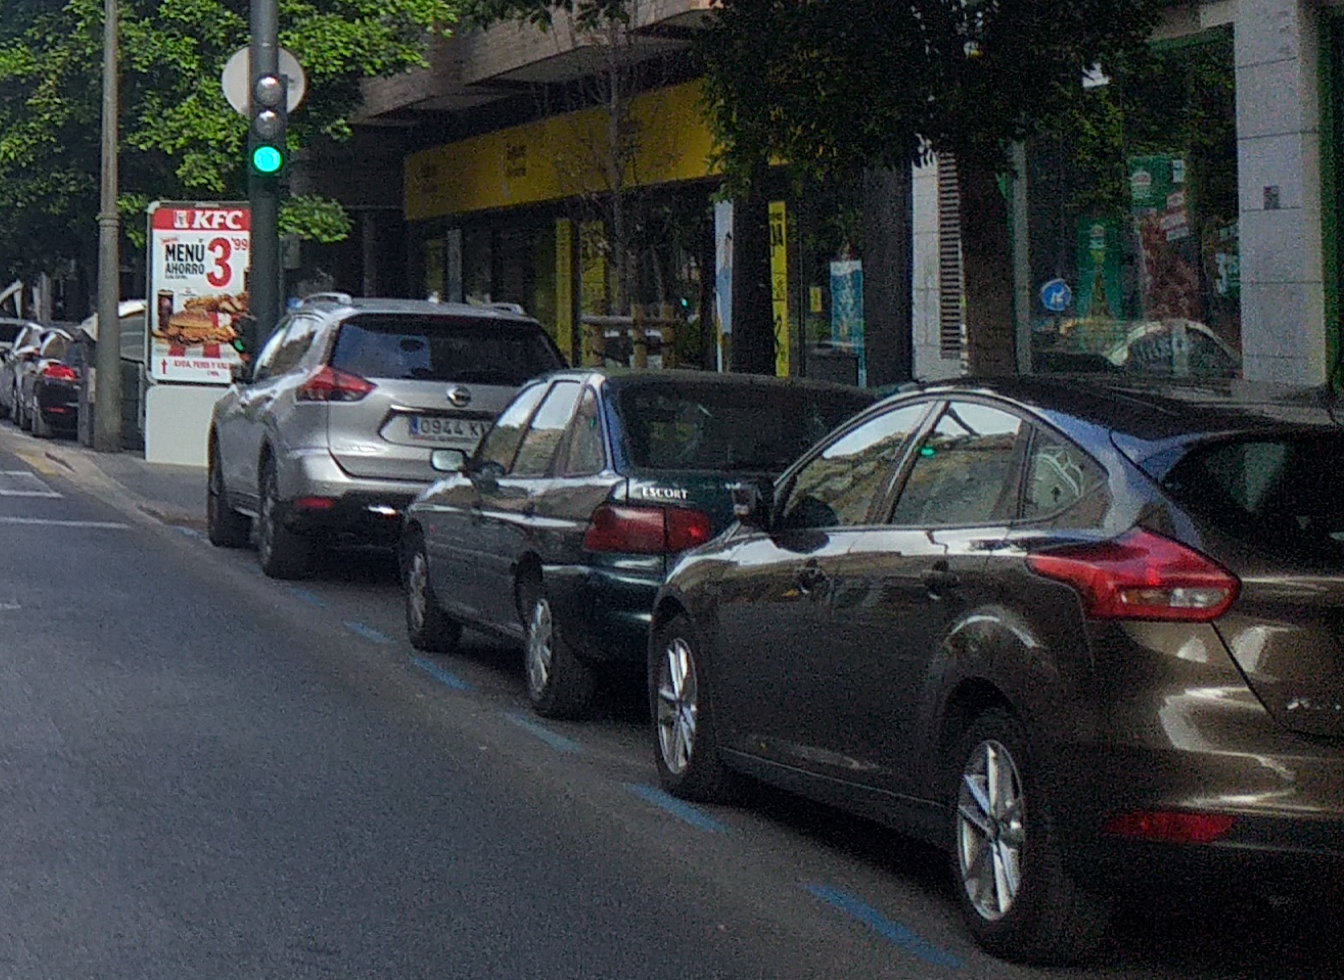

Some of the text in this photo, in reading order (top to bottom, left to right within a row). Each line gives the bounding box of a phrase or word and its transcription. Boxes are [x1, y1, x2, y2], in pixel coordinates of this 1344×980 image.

[191, 209, 243, 230] KFC
[165, 238, 205, 262] MENÚ
[165, 262, 205, 275] AHORRO
[420, 419, 464, 436] 0944
[642, 486, 689, 500] ESCORT
